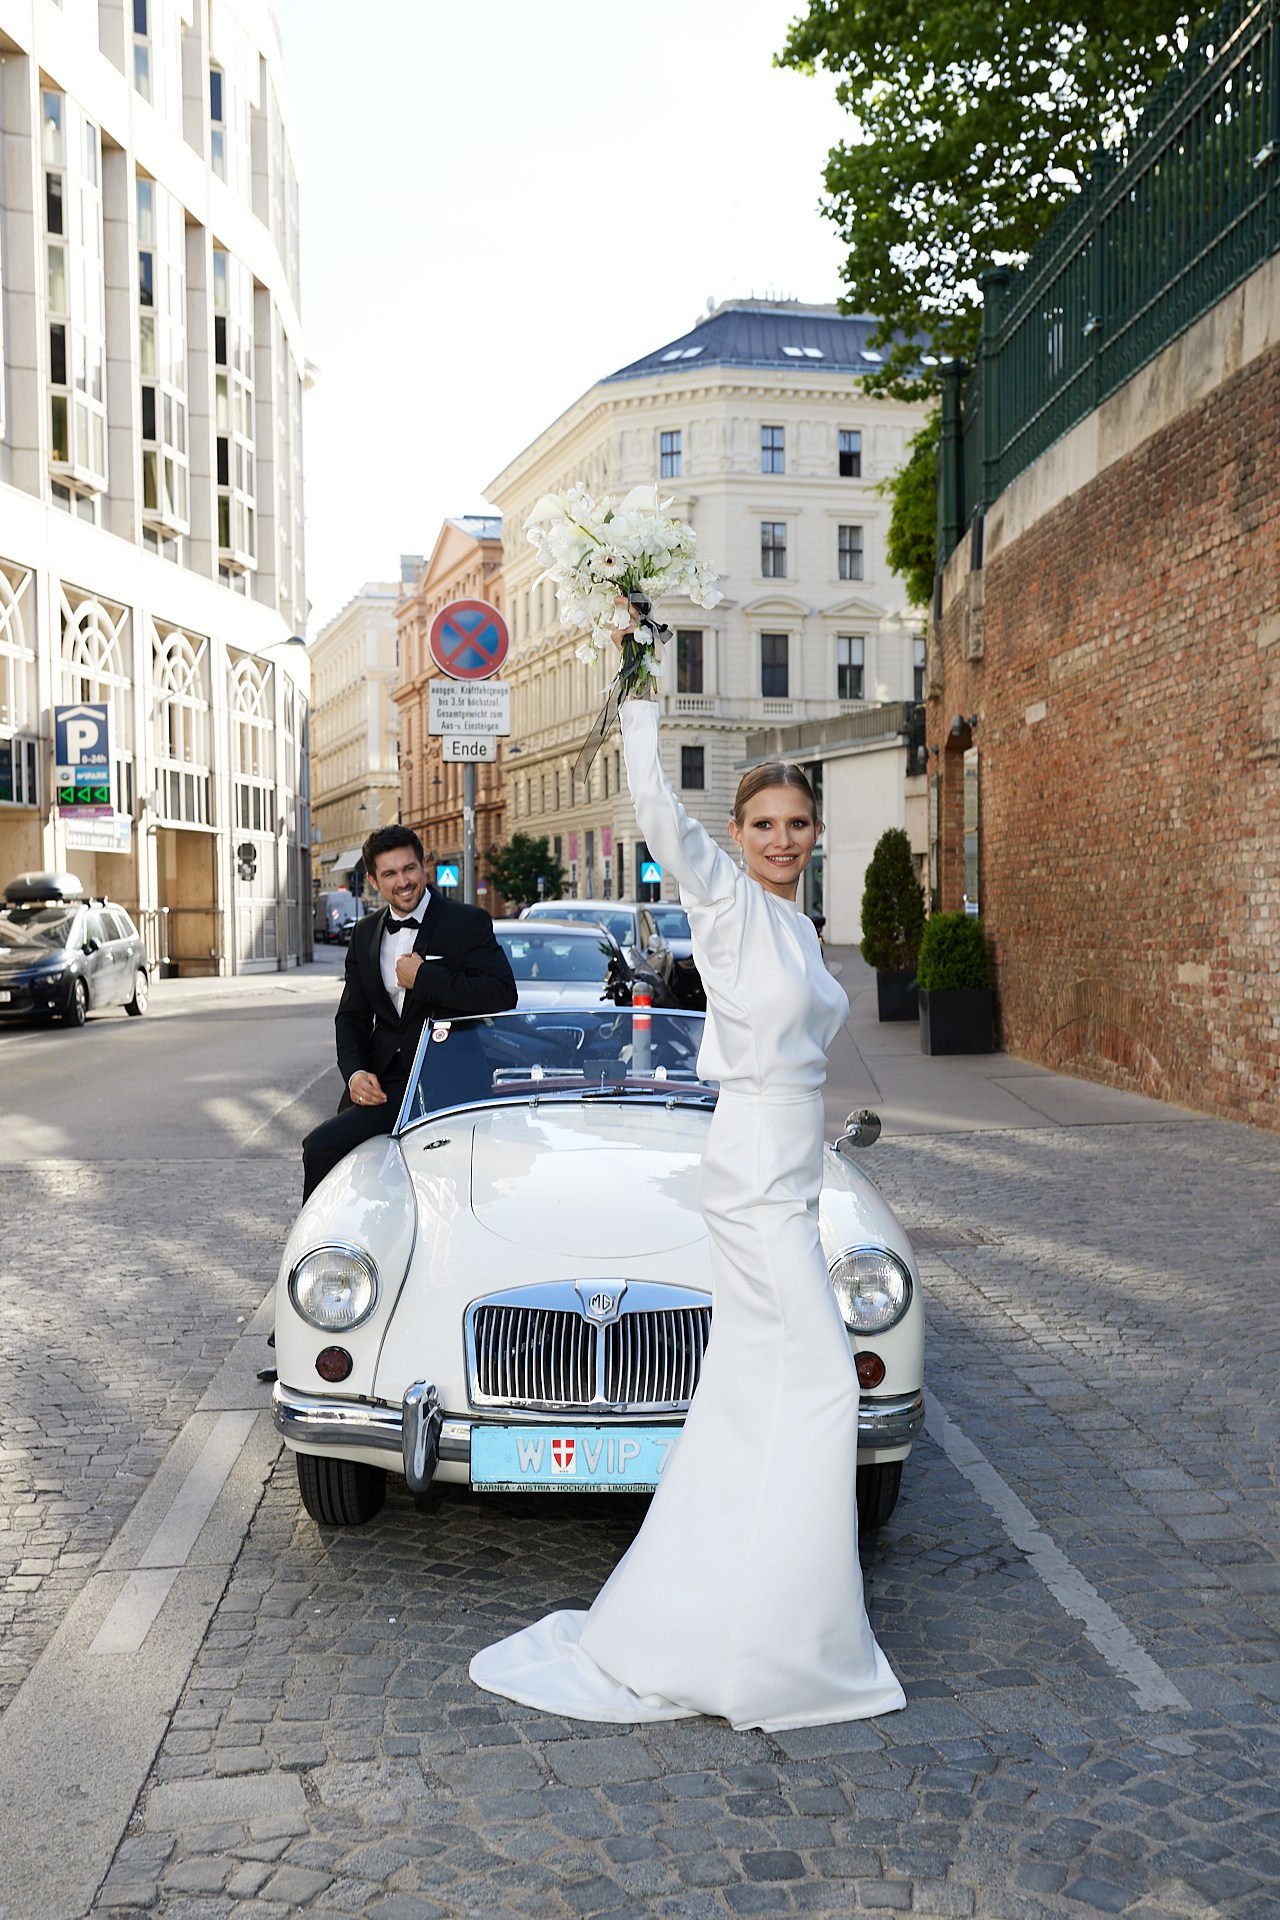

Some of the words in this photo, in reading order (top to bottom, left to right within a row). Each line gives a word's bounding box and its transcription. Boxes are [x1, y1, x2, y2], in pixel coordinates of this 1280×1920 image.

[460, 685, 509, 697] Kraftfahrzeuge
[438, 697, 449, 706] bis
[436, 709, 487, 719] Gesamtgewicht
[464, 721, 499, 731] Einsteigen
[66, 719, 99, 765] P
[452, 741, 487, 756] Ende
[81, 753, 107, 765] 0-24h
[592, 1294, 611, 1311] MG
[516, 1437, 546, 1474] W
[581, 1438, 641, 1475] VIP
[557, 1484, 602, 1492] HOCHZEITS
[608, 1484, 656, 1492] LIMOUSINEN
